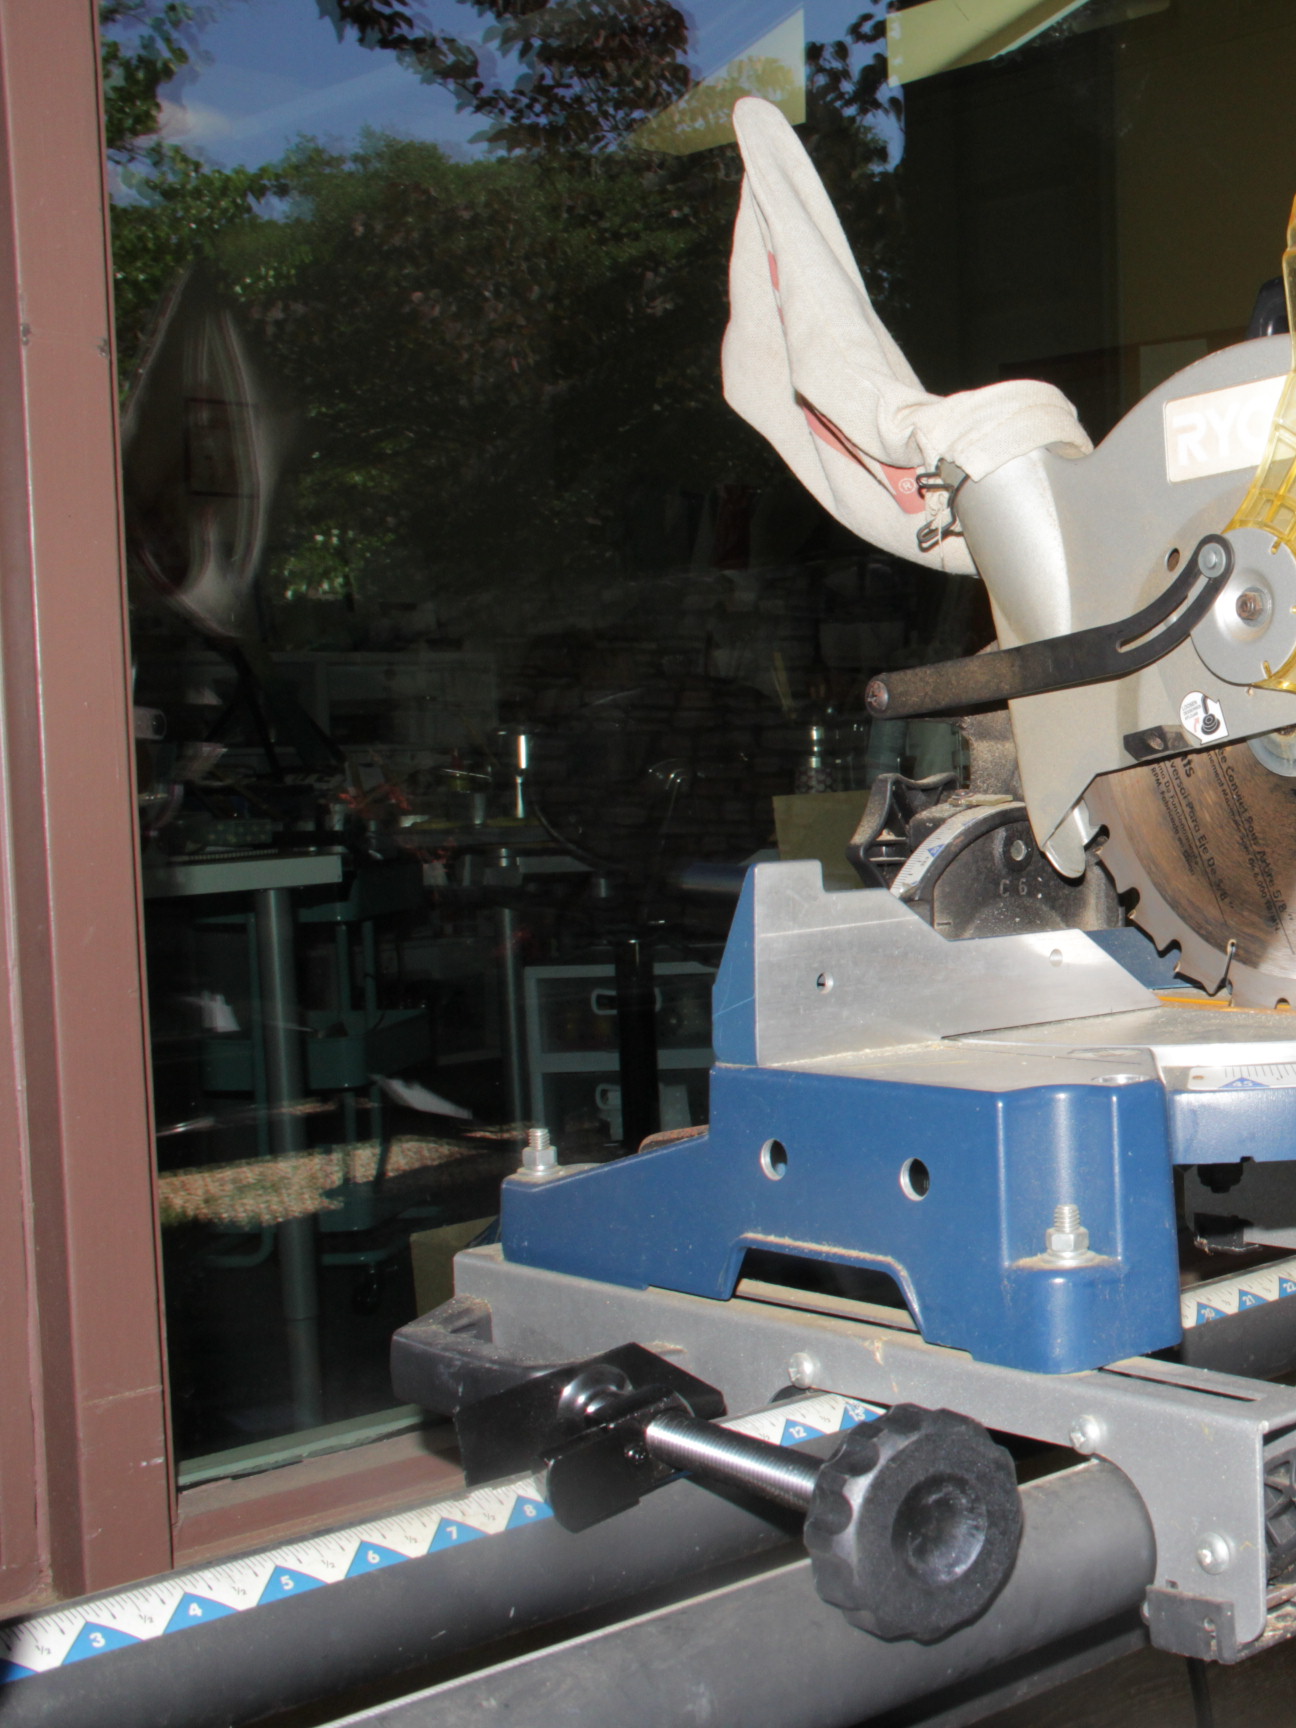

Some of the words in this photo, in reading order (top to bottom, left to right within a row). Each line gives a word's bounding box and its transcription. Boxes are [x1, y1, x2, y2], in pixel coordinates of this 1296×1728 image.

[1242, 1294, 1256, 1306] 21
[1282, 1281, 1296, 1293] 22
[787, 1425, 808, 1439] 12
[89, 1631, 106, 1648] 3
[188, 1602, 203, 1617] 4
[279, 1574, 295, 1590] 5
[366, 1550, 381, 1564] 6
[446, 1525, 459, 1540] 7
[522, 1503, 537, 1518] 8
